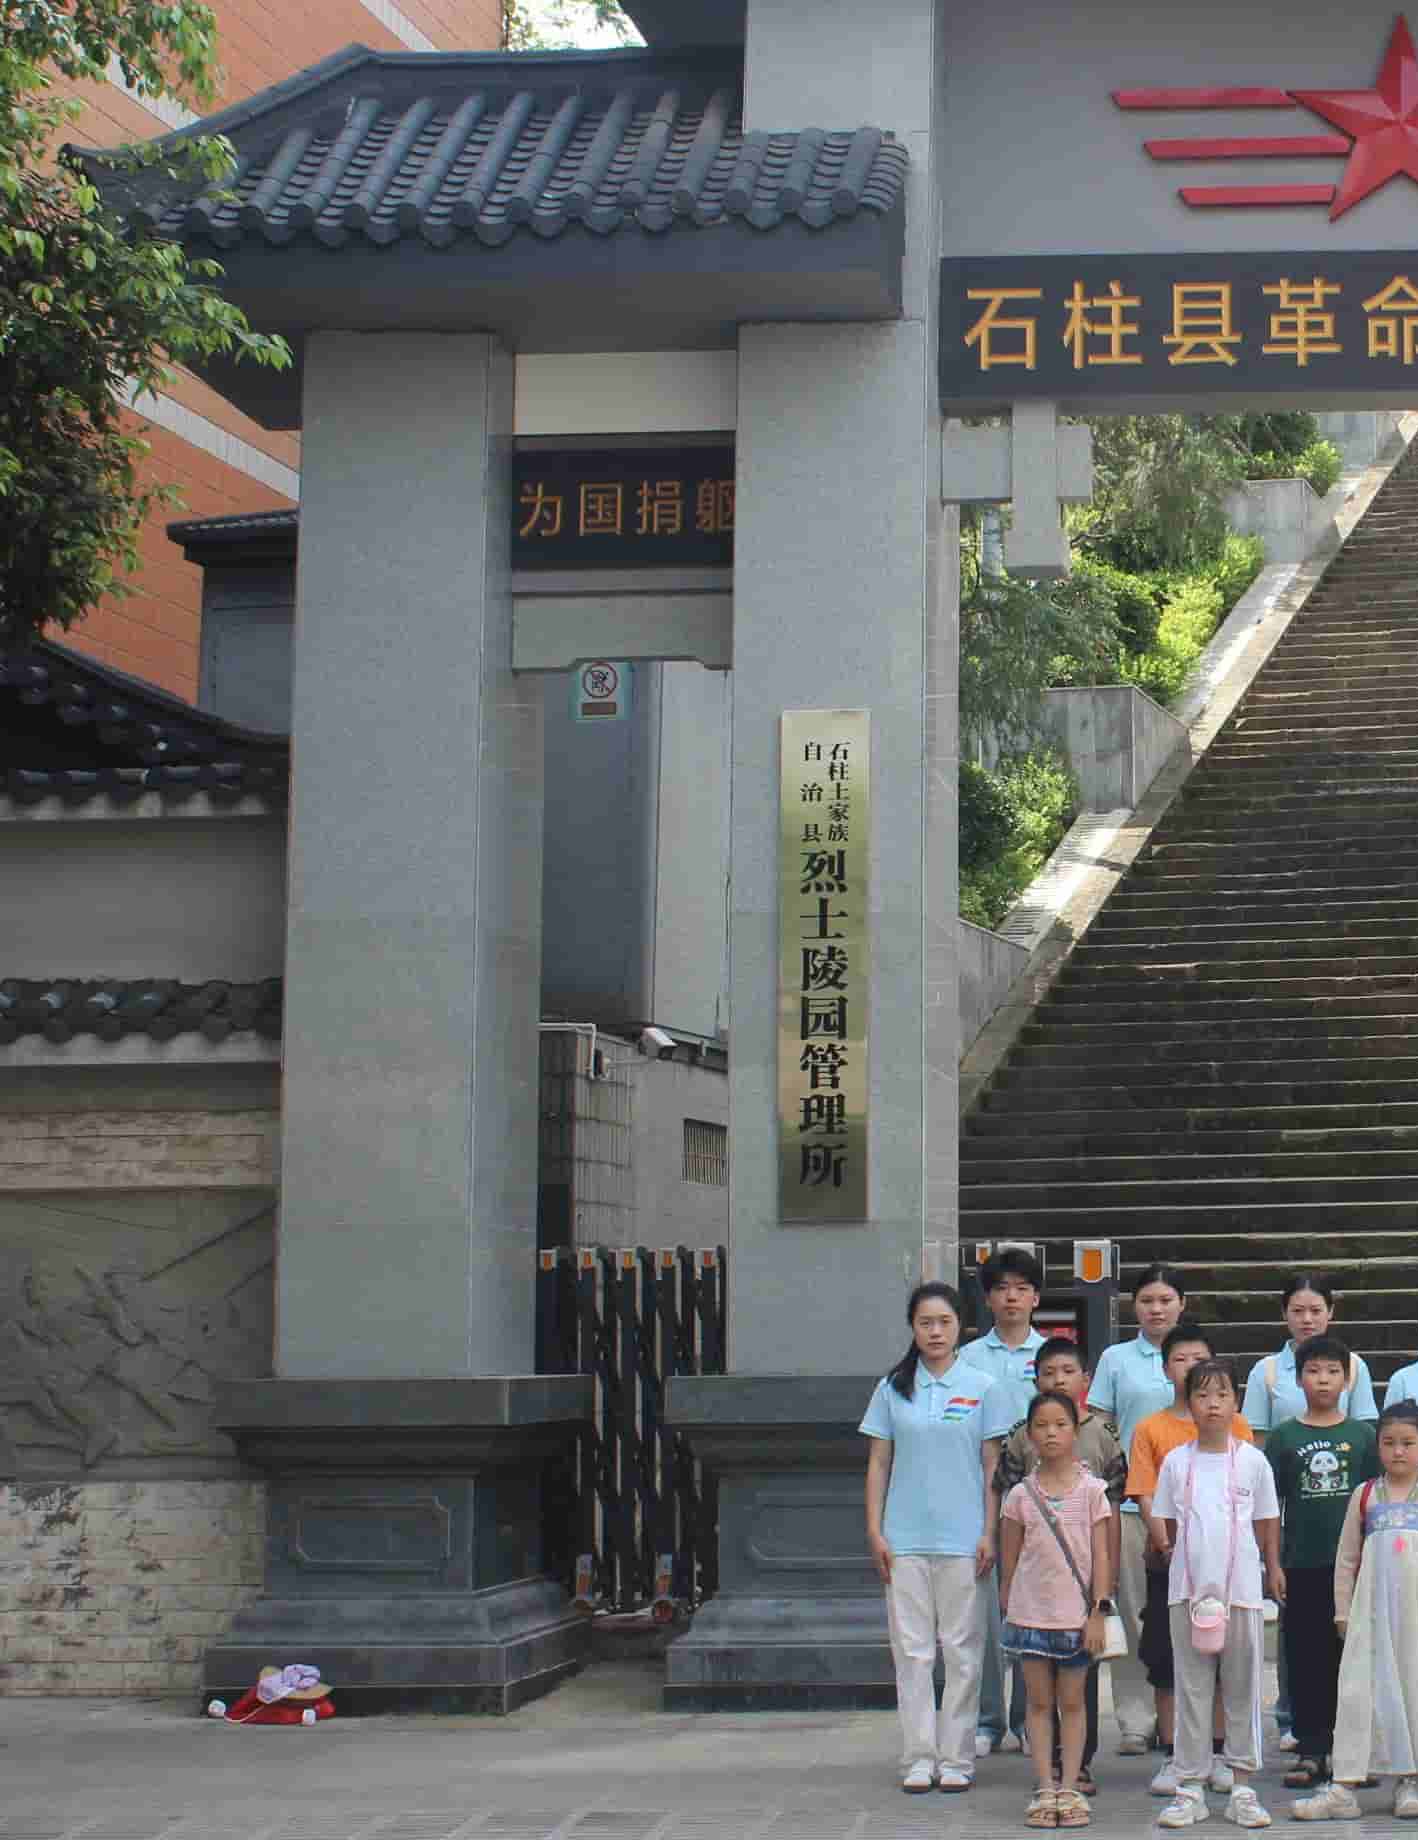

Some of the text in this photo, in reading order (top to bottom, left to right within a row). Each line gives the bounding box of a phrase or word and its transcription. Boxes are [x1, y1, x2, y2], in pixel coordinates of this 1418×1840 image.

[800, 741, 823, 842] 自治县
[827, 741, 849, 843] 石柱土家族
[799, 848, 849, 1188] 烈士陵园管理所
